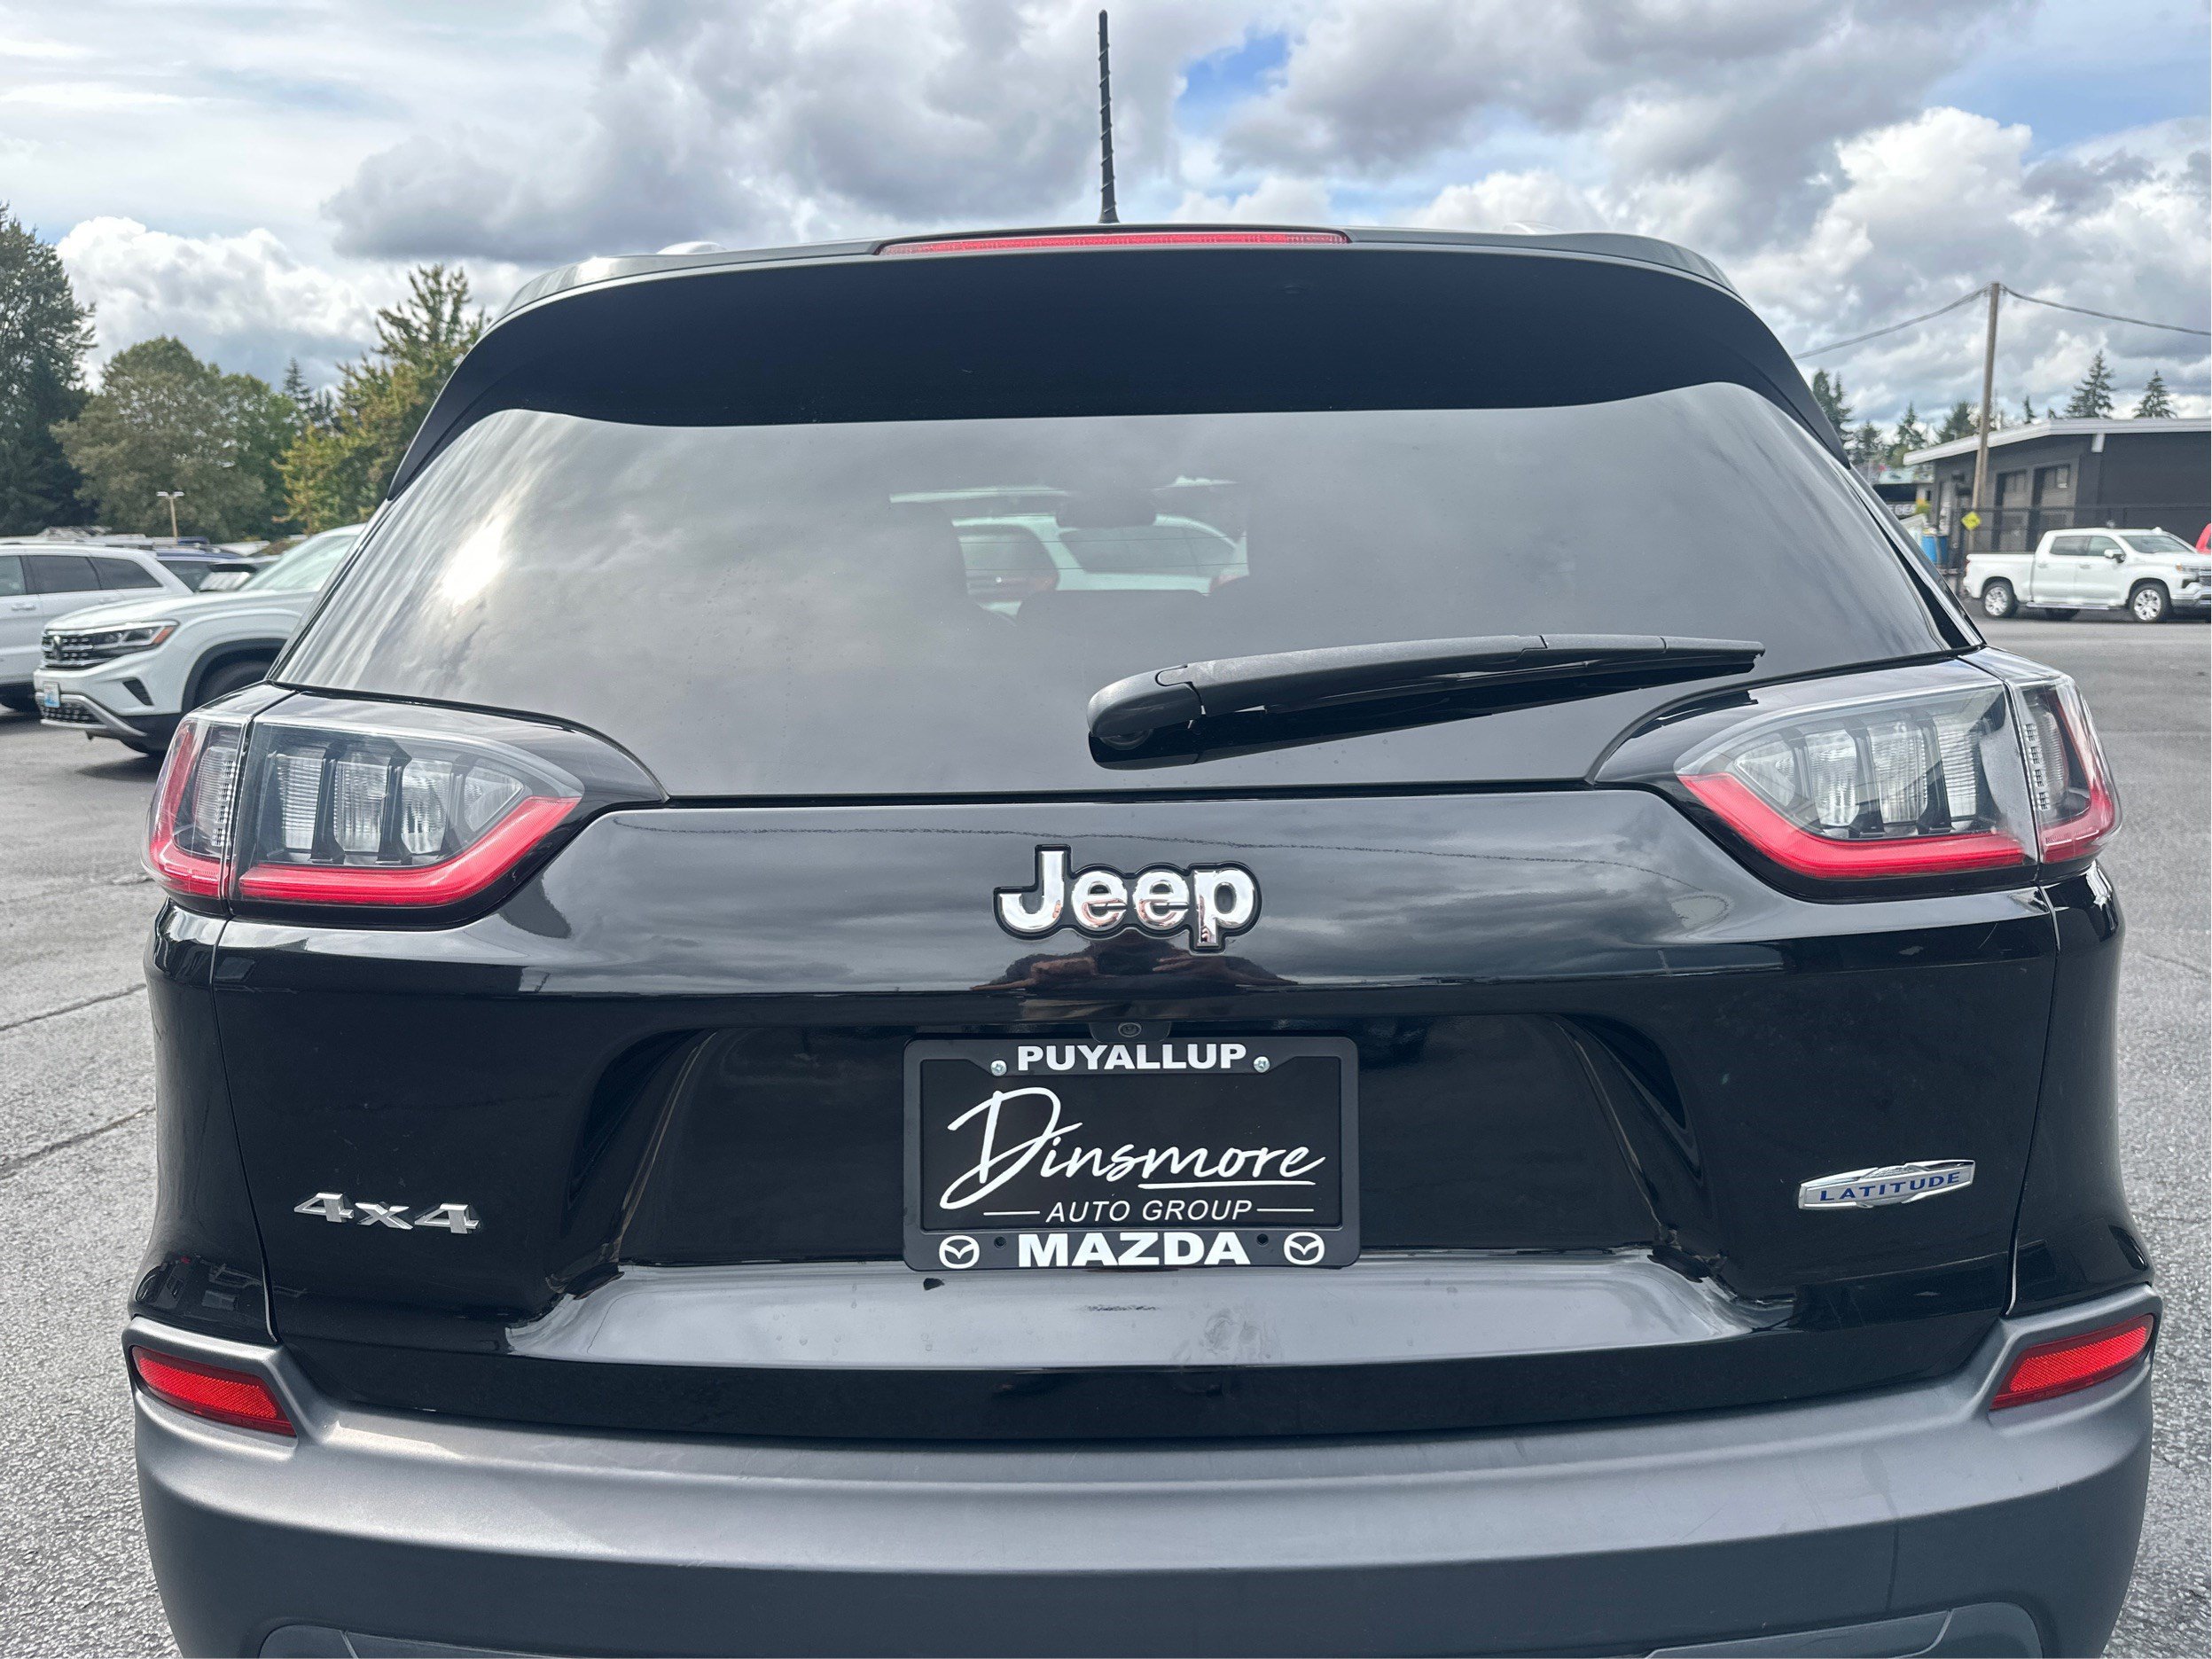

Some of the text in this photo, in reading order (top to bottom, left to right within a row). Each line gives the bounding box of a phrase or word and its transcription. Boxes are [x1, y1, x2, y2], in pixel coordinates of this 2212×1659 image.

[997, 848, 1257, 950] Jeep
[1018, 1043, 1247, 1071] PUYALLUP
[939, 1086, 1326, 1210] Dinsmore
[1819, 1171, 1960, 1201] LATITUDE
[293, 1192, 481, 1234] 4x4
[1045, 1199, 1253, 1223] AUTO GROUP
[1018, 1232, 1251, 1268] MAZDA
